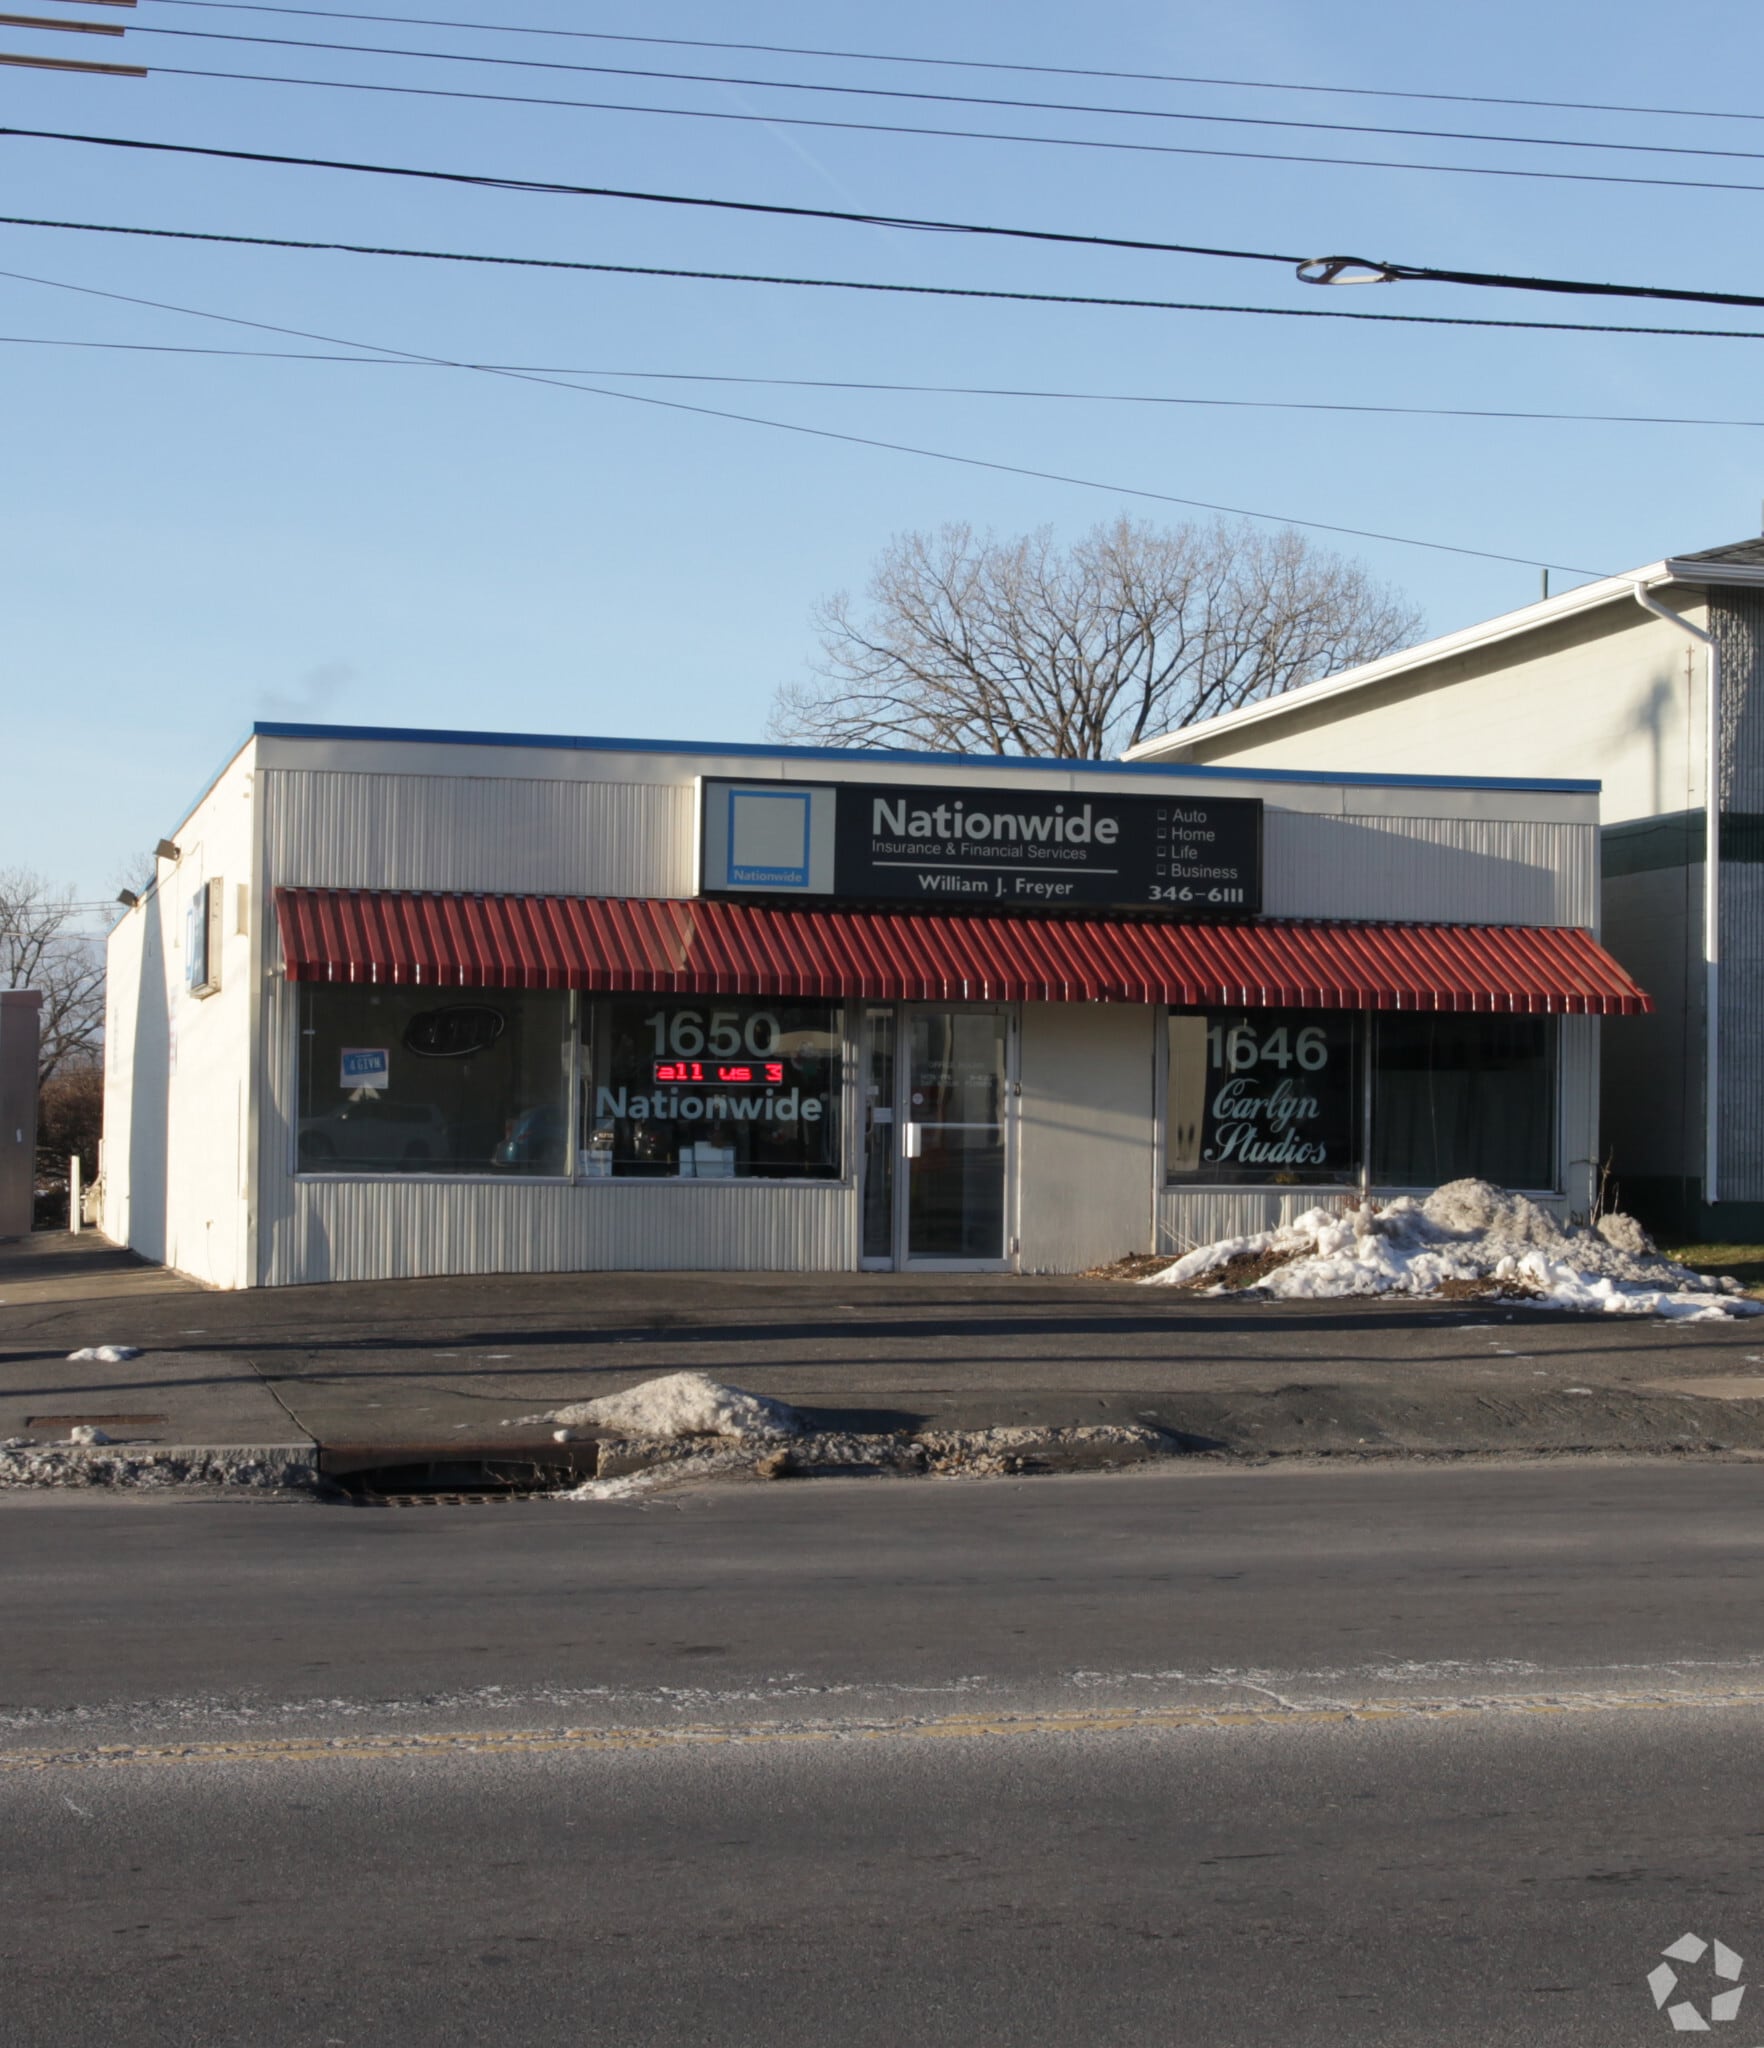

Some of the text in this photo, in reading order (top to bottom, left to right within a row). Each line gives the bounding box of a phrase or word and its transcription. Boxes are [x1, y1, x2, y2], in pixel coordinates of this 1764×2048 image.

[873, 799, 1119, 844] Nationwide
[1172, 808, 1207, 823] Auto
[1171, 826, 1216, 841] Home
[872, 839, 1087, 860] Insurance & Financial Services
[1171, 844, 1198, 860] Life
[734, 869, 802, 883] Nationwide
[1171, 863, 1239, 879] Business
[918, 874, 1073, 898] William J. Freyer
[1148, 885, 1244, 903] 346-6111
[644, 1010, 781, 1058] 1650
[1207, 1025, 1328, 1071] 1646
[718, 1066, 752, 1081] us
[765, 1063, 783, 1081] 3
[595, 1086, 822, 1121] Nationwide
[1212, 1078, 1320, 1133] Carlyn
[1203, 1122, 1327, 1164] Studios
